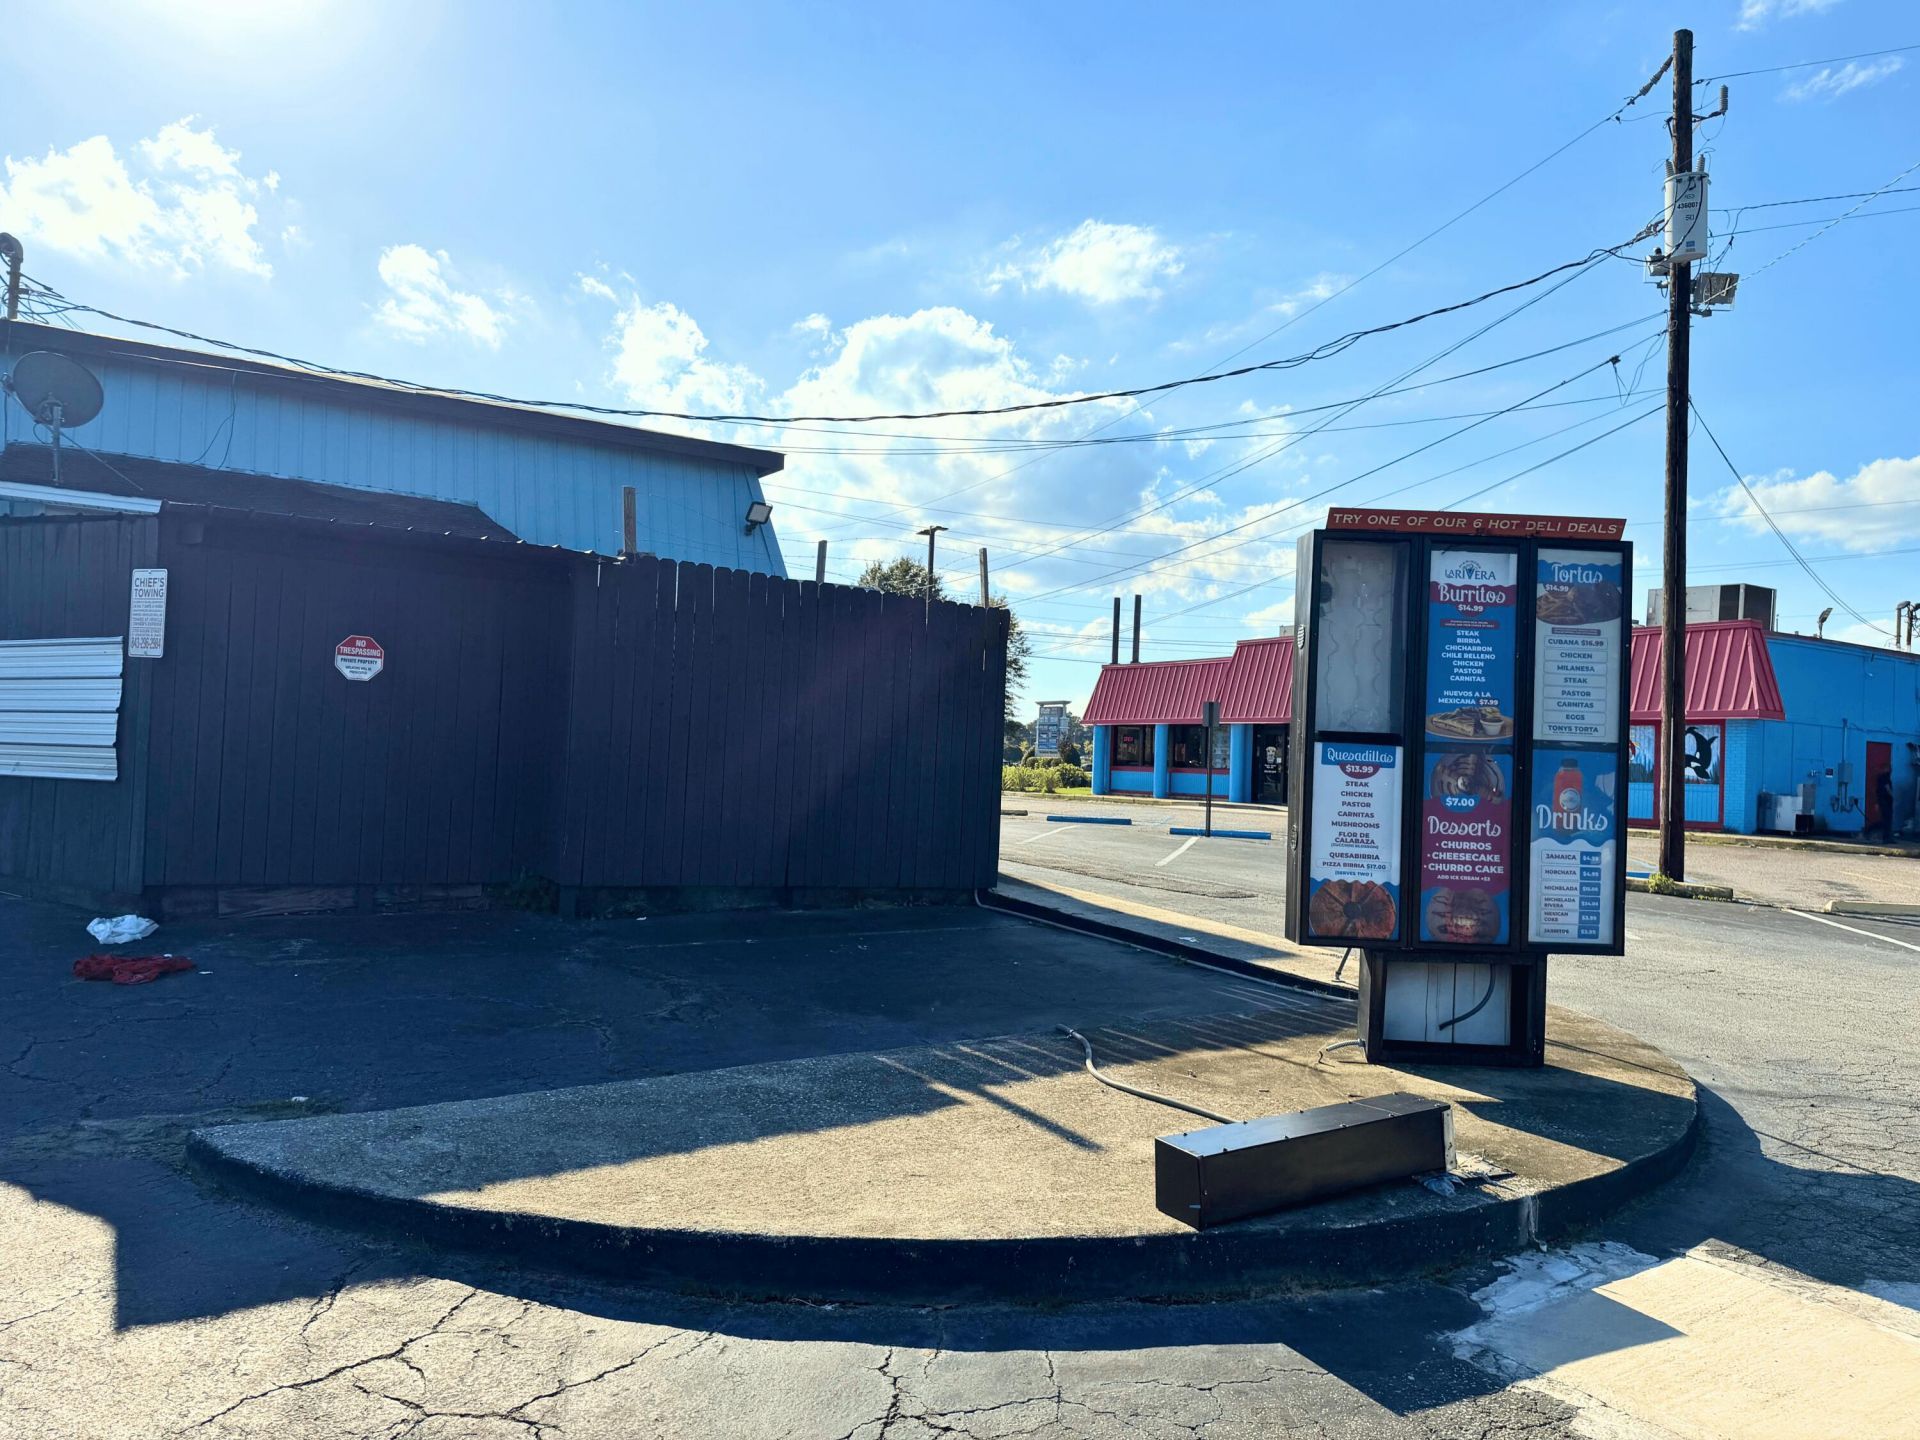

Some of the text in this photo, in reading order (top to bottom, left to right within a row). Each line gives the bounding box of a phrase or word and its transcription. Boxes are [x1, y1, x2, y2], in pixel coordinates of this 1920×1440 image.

[1333, 514, 1617, 534] TRY ONE OF OUR 6 HOT DELI DEALS
[1552, 562, 1603, 584] Tortas
[134, 578, 164, 588] CHIEF'S
[134, 588, 164, 598] TOWING
[1438, 583, 1506, 604] Burritos
[1458, 604, 1484, 612] $14.99
[340, 646, 380, 656] TRESPASSING
[1328, 748, 1393, 763] Quesadillas
[1346, 764, 1373, 773] $13.99
[1446, 797, 1474, 807] $7.00
[1536, 804, 1608, 831] Drinks
[1331, 821, 1380, 829] MUSHROOMS
[1428, 815, 1501, 837] Desserts
[1441, 841, 1492, 850] CHURROS
[1329, 852, 1380, 860] QUESABIRRIA
[1432, 852, 1500, 862] CHEESECAKE
[1428, 863, 1504, 873] CHURRO CAKE
